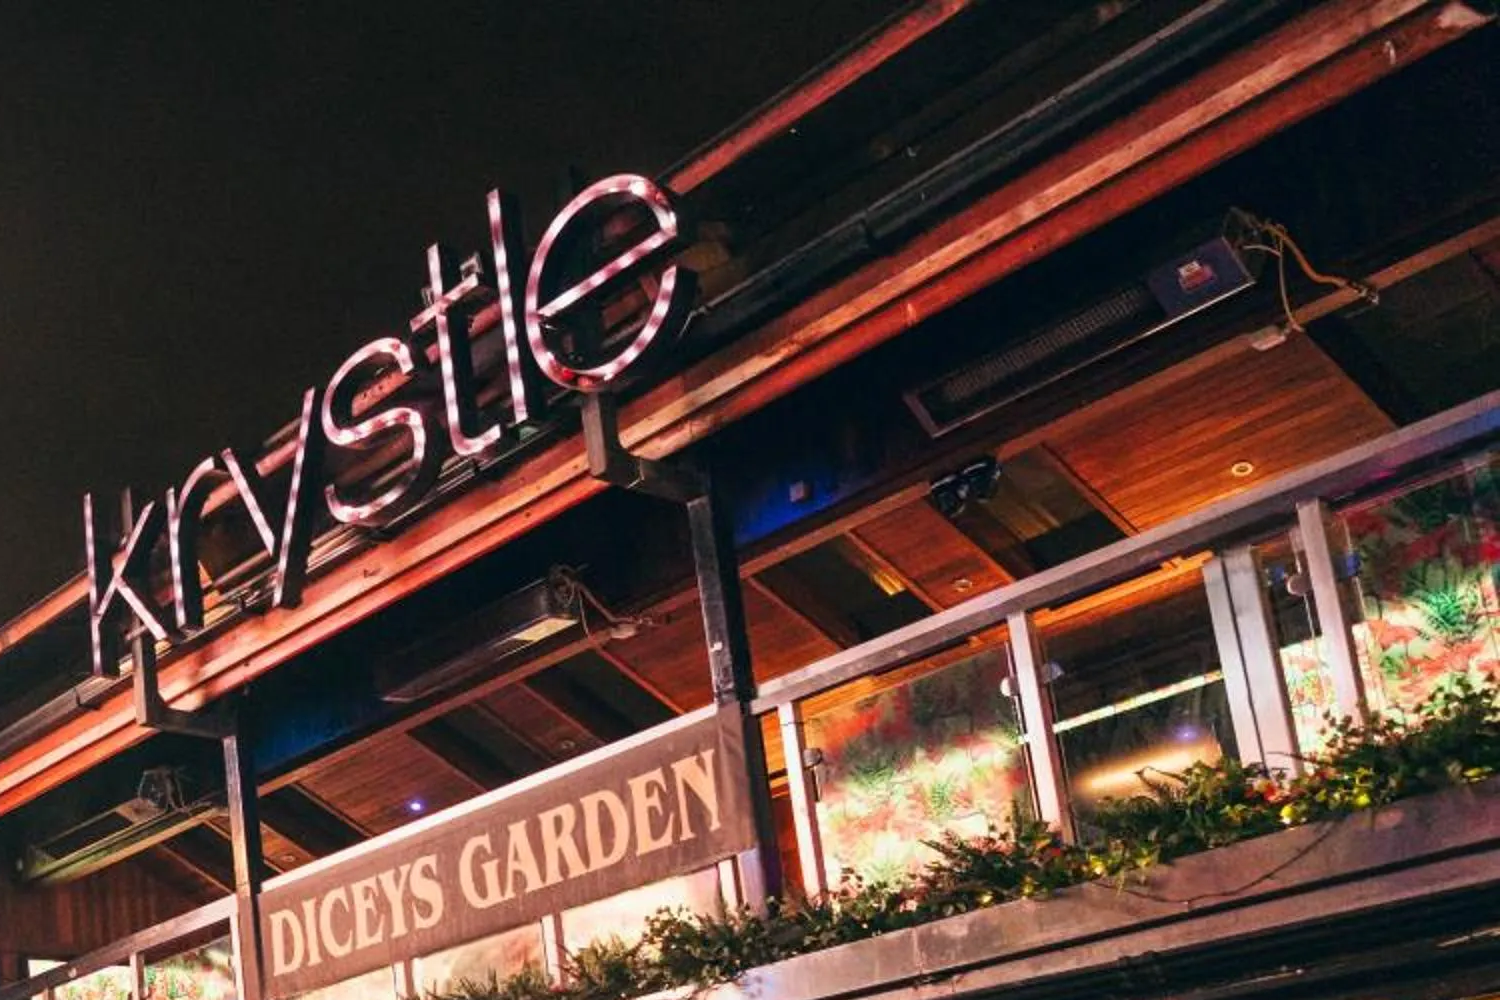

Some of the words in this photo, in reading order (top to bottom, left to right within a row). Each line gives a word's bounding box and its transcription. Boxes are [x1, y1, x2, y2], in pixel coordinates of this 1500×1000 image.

[83, 172, 678, 679] krystle
[268, 854, 444, 977] DICEYS
[458, 748, 722, 910] GARDEN
